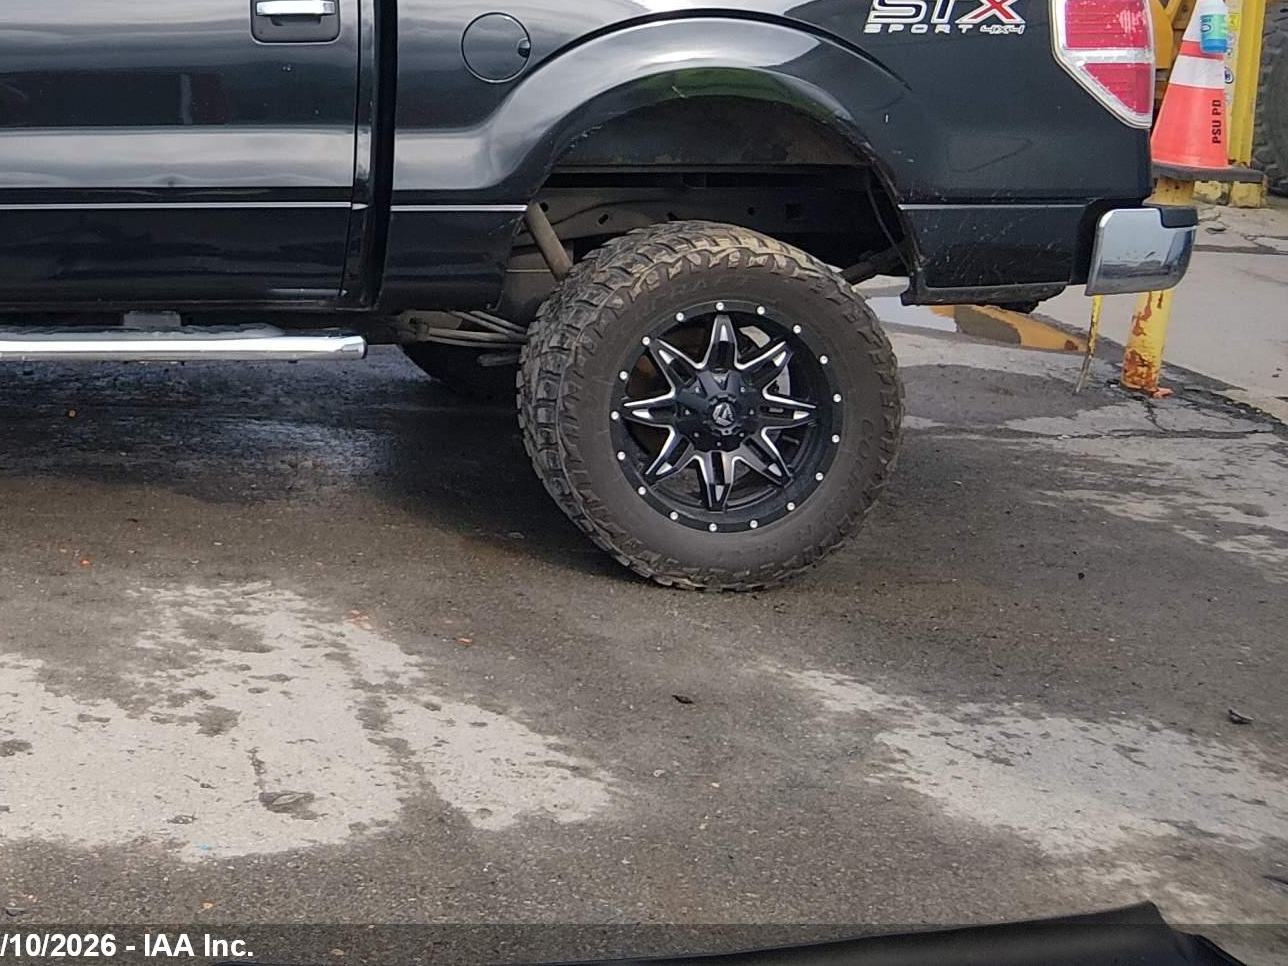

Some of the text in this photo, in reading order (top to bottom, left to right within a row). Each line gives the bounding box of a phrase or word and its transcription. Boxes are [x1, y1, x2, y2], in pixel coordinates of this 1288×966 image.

[863, 24, 974, 34] SPORT
[1211, 99, 1222, 144] PSU PD
